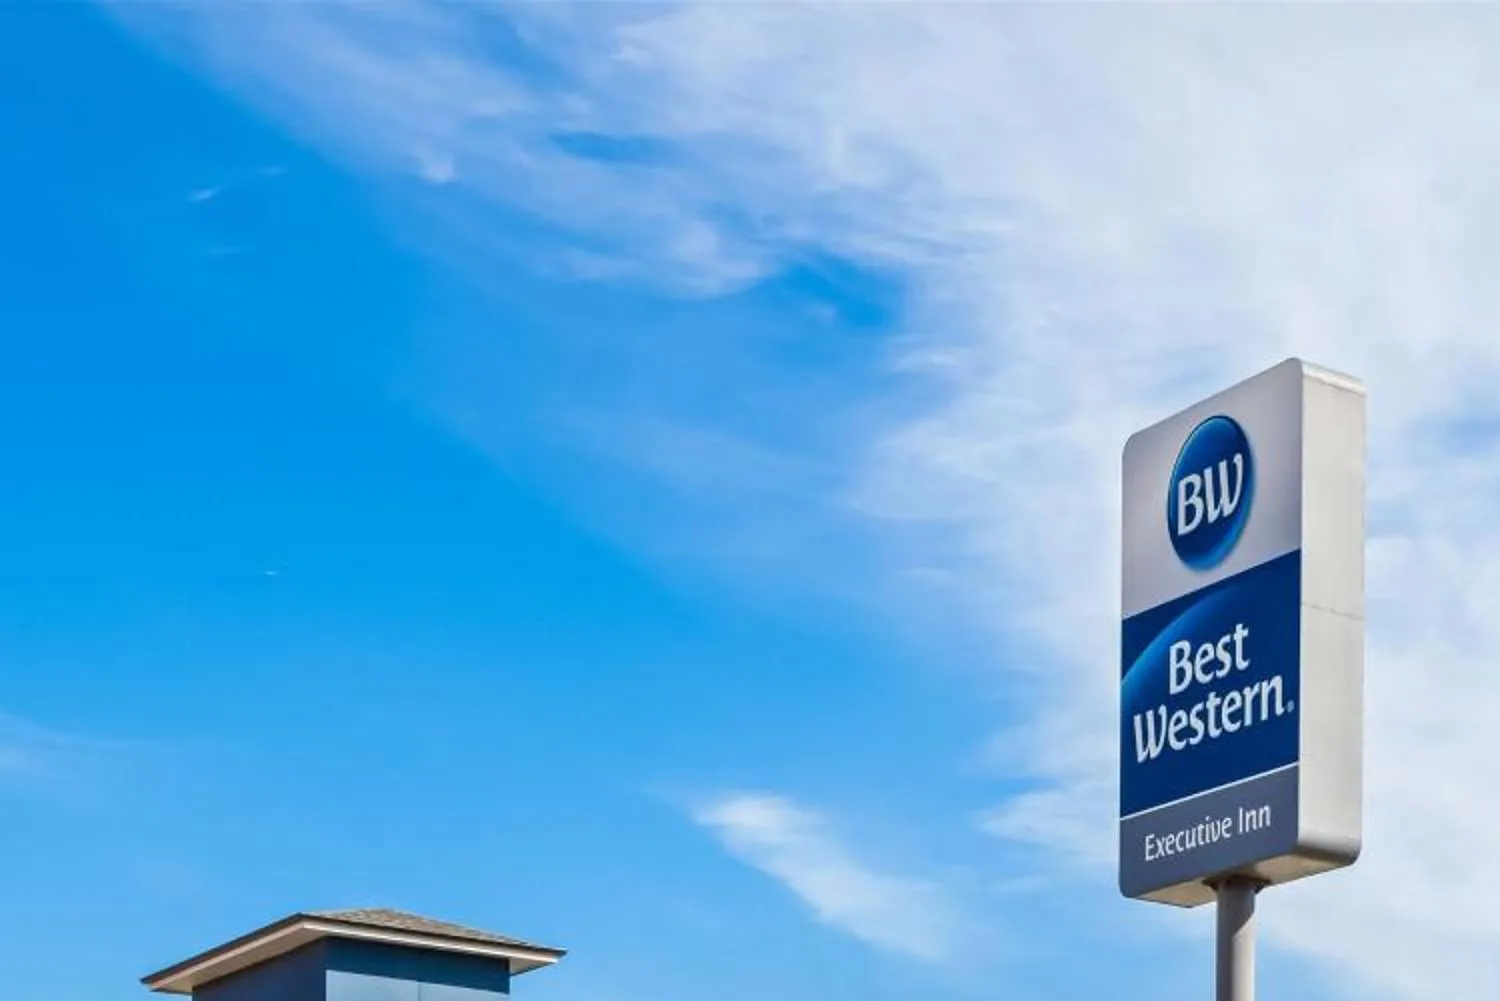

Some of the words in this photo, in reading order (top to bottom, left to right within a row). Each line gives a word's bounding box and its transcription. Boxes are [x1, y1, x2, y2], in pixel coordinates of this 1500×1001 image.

[1177, 452, 1243, 536] BW
[1168, 623, 1249, 695] Best
[1133, 674, 1285, 764] Western
[1144, 812, 1231, 861] Executive
[1238, 803, 1271, 834] Inn
